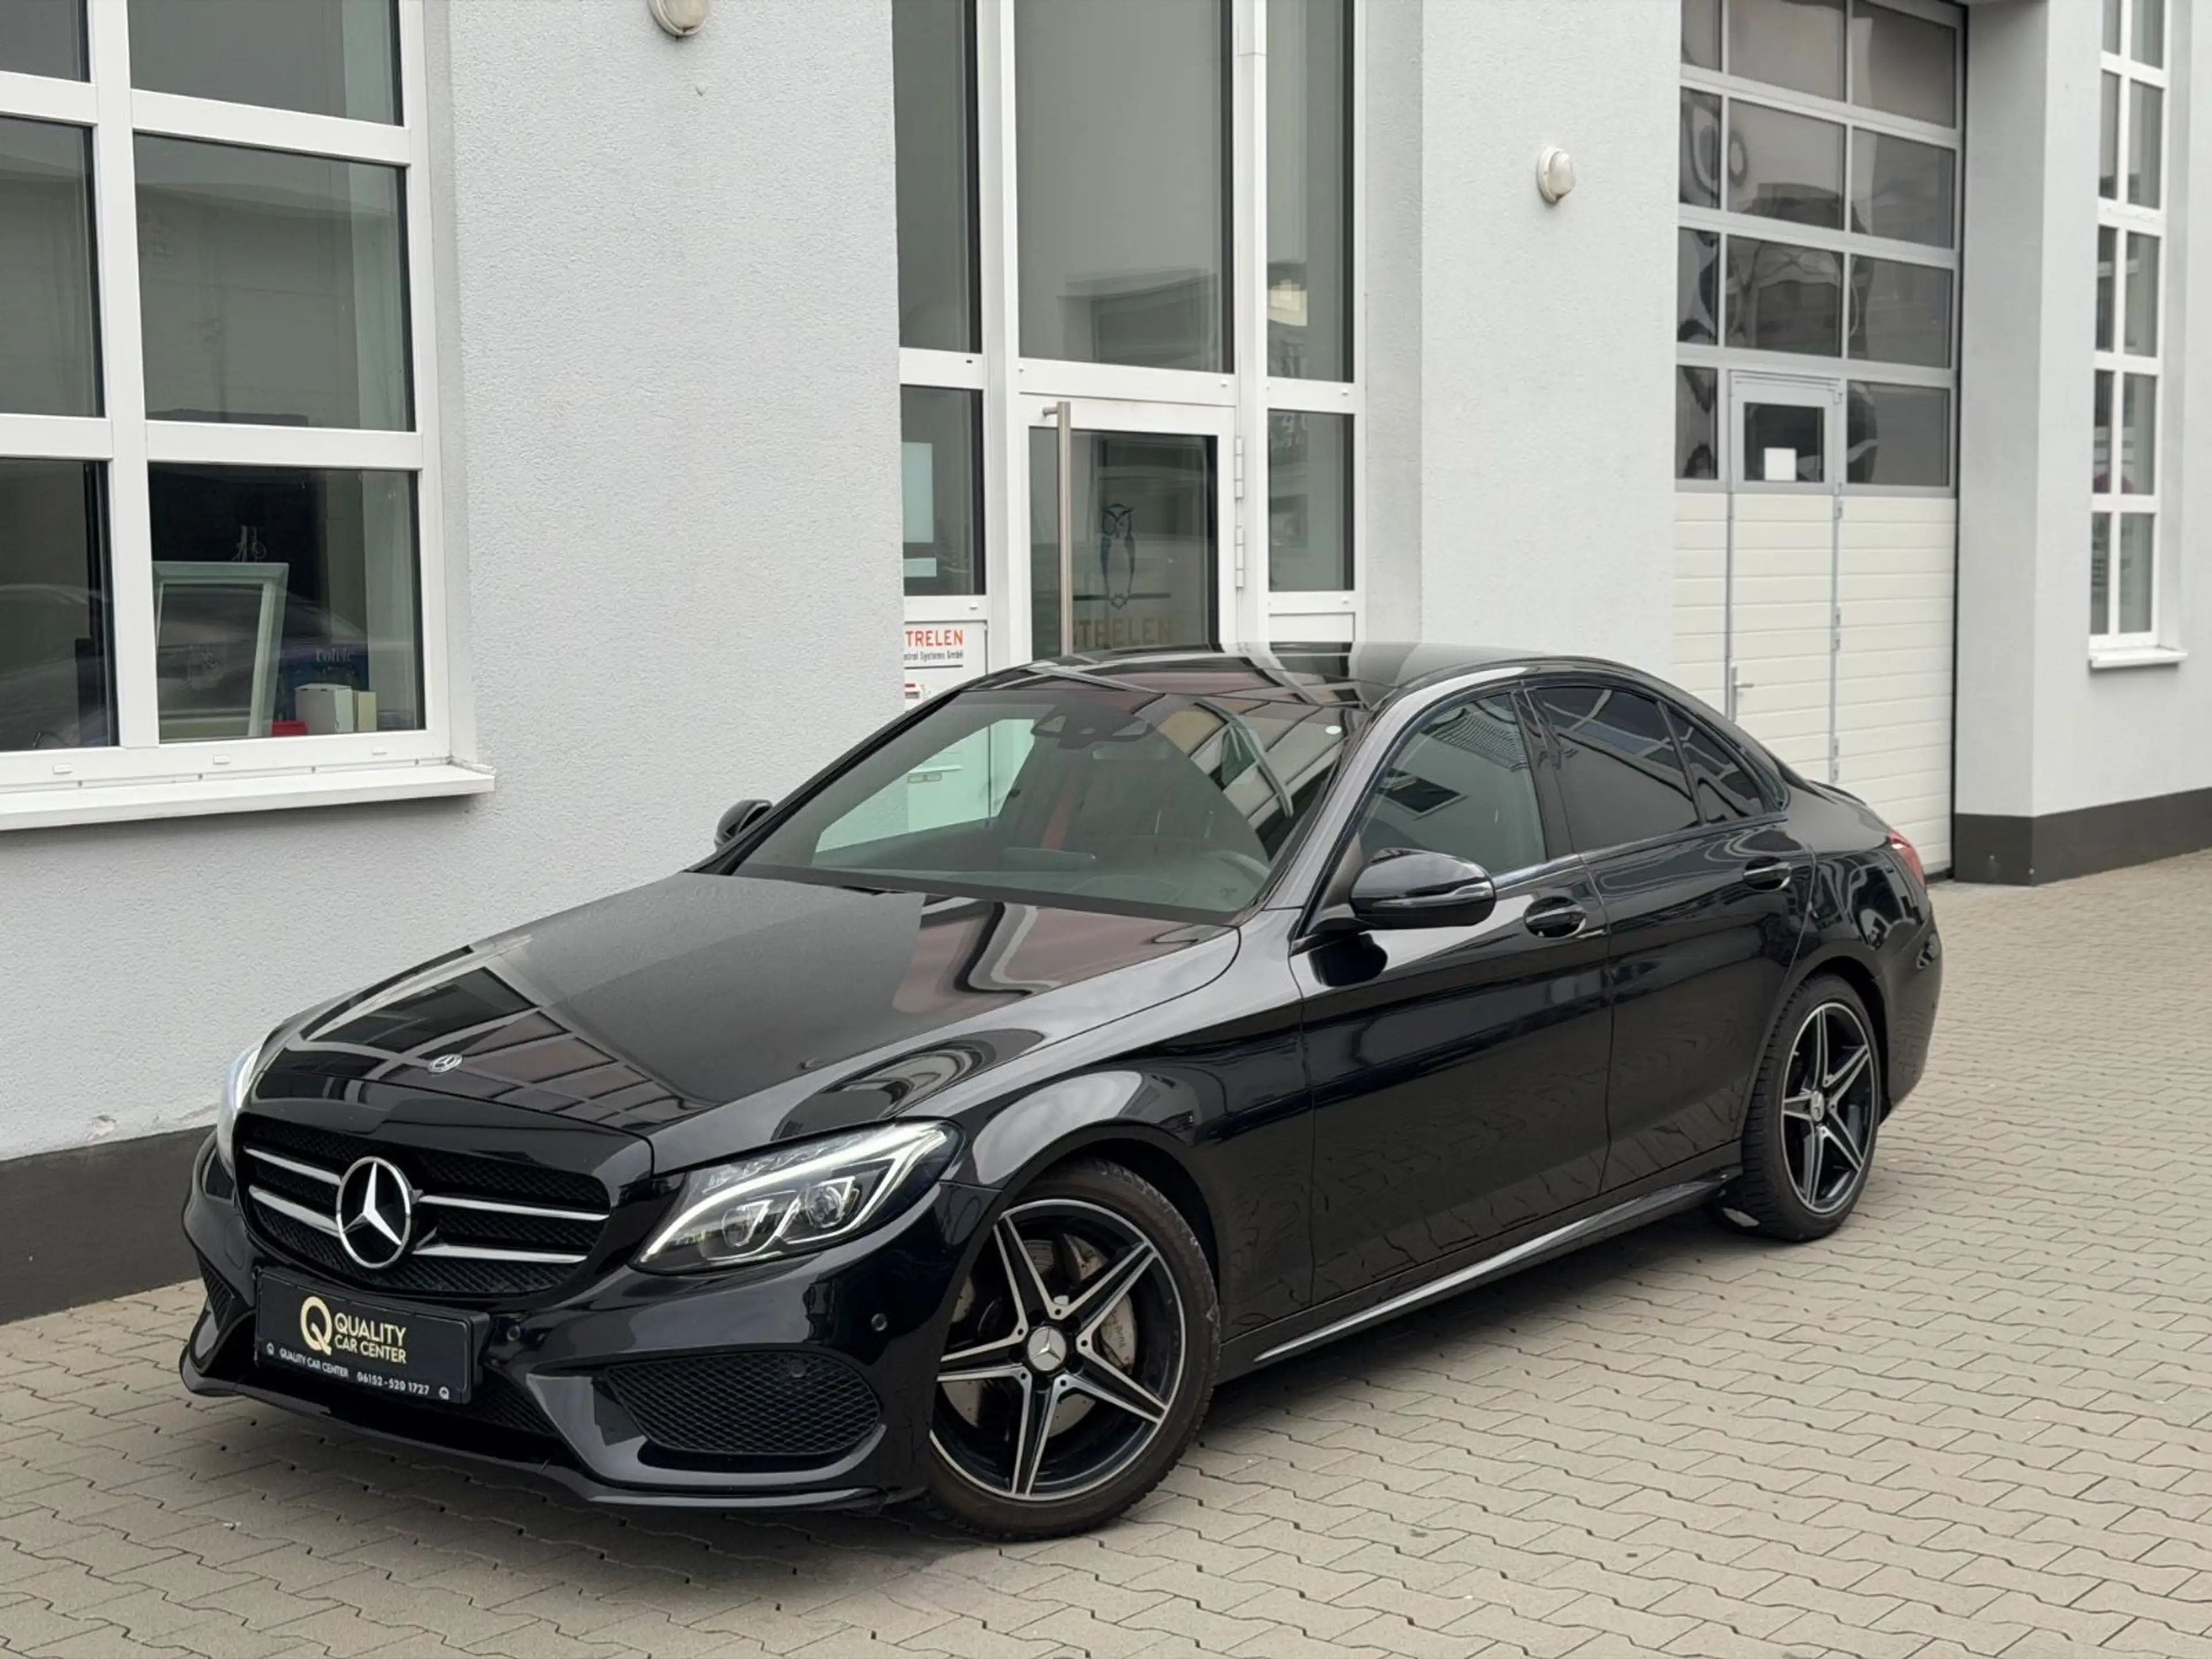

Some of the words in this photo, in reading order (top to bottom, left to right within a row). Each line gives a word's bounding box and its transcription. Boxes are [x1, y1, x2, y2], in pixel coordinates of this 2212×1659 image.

[904, 629, 964, 647] TRELEN
[1073, 616, 1174, 648] TRELEN
[334, 1312, 407, 1347] QUALITY
[334, 1334, 358, 1354] CAR
[360, 1340, 407, 1364] CENTER
[279, 1347, 306, 1365] QUALITY
[306, 1356, 321, 1370] CAR
[321, 1361, 349, 1378] CENTER
[407, 1381, 430, 1396] 1727
